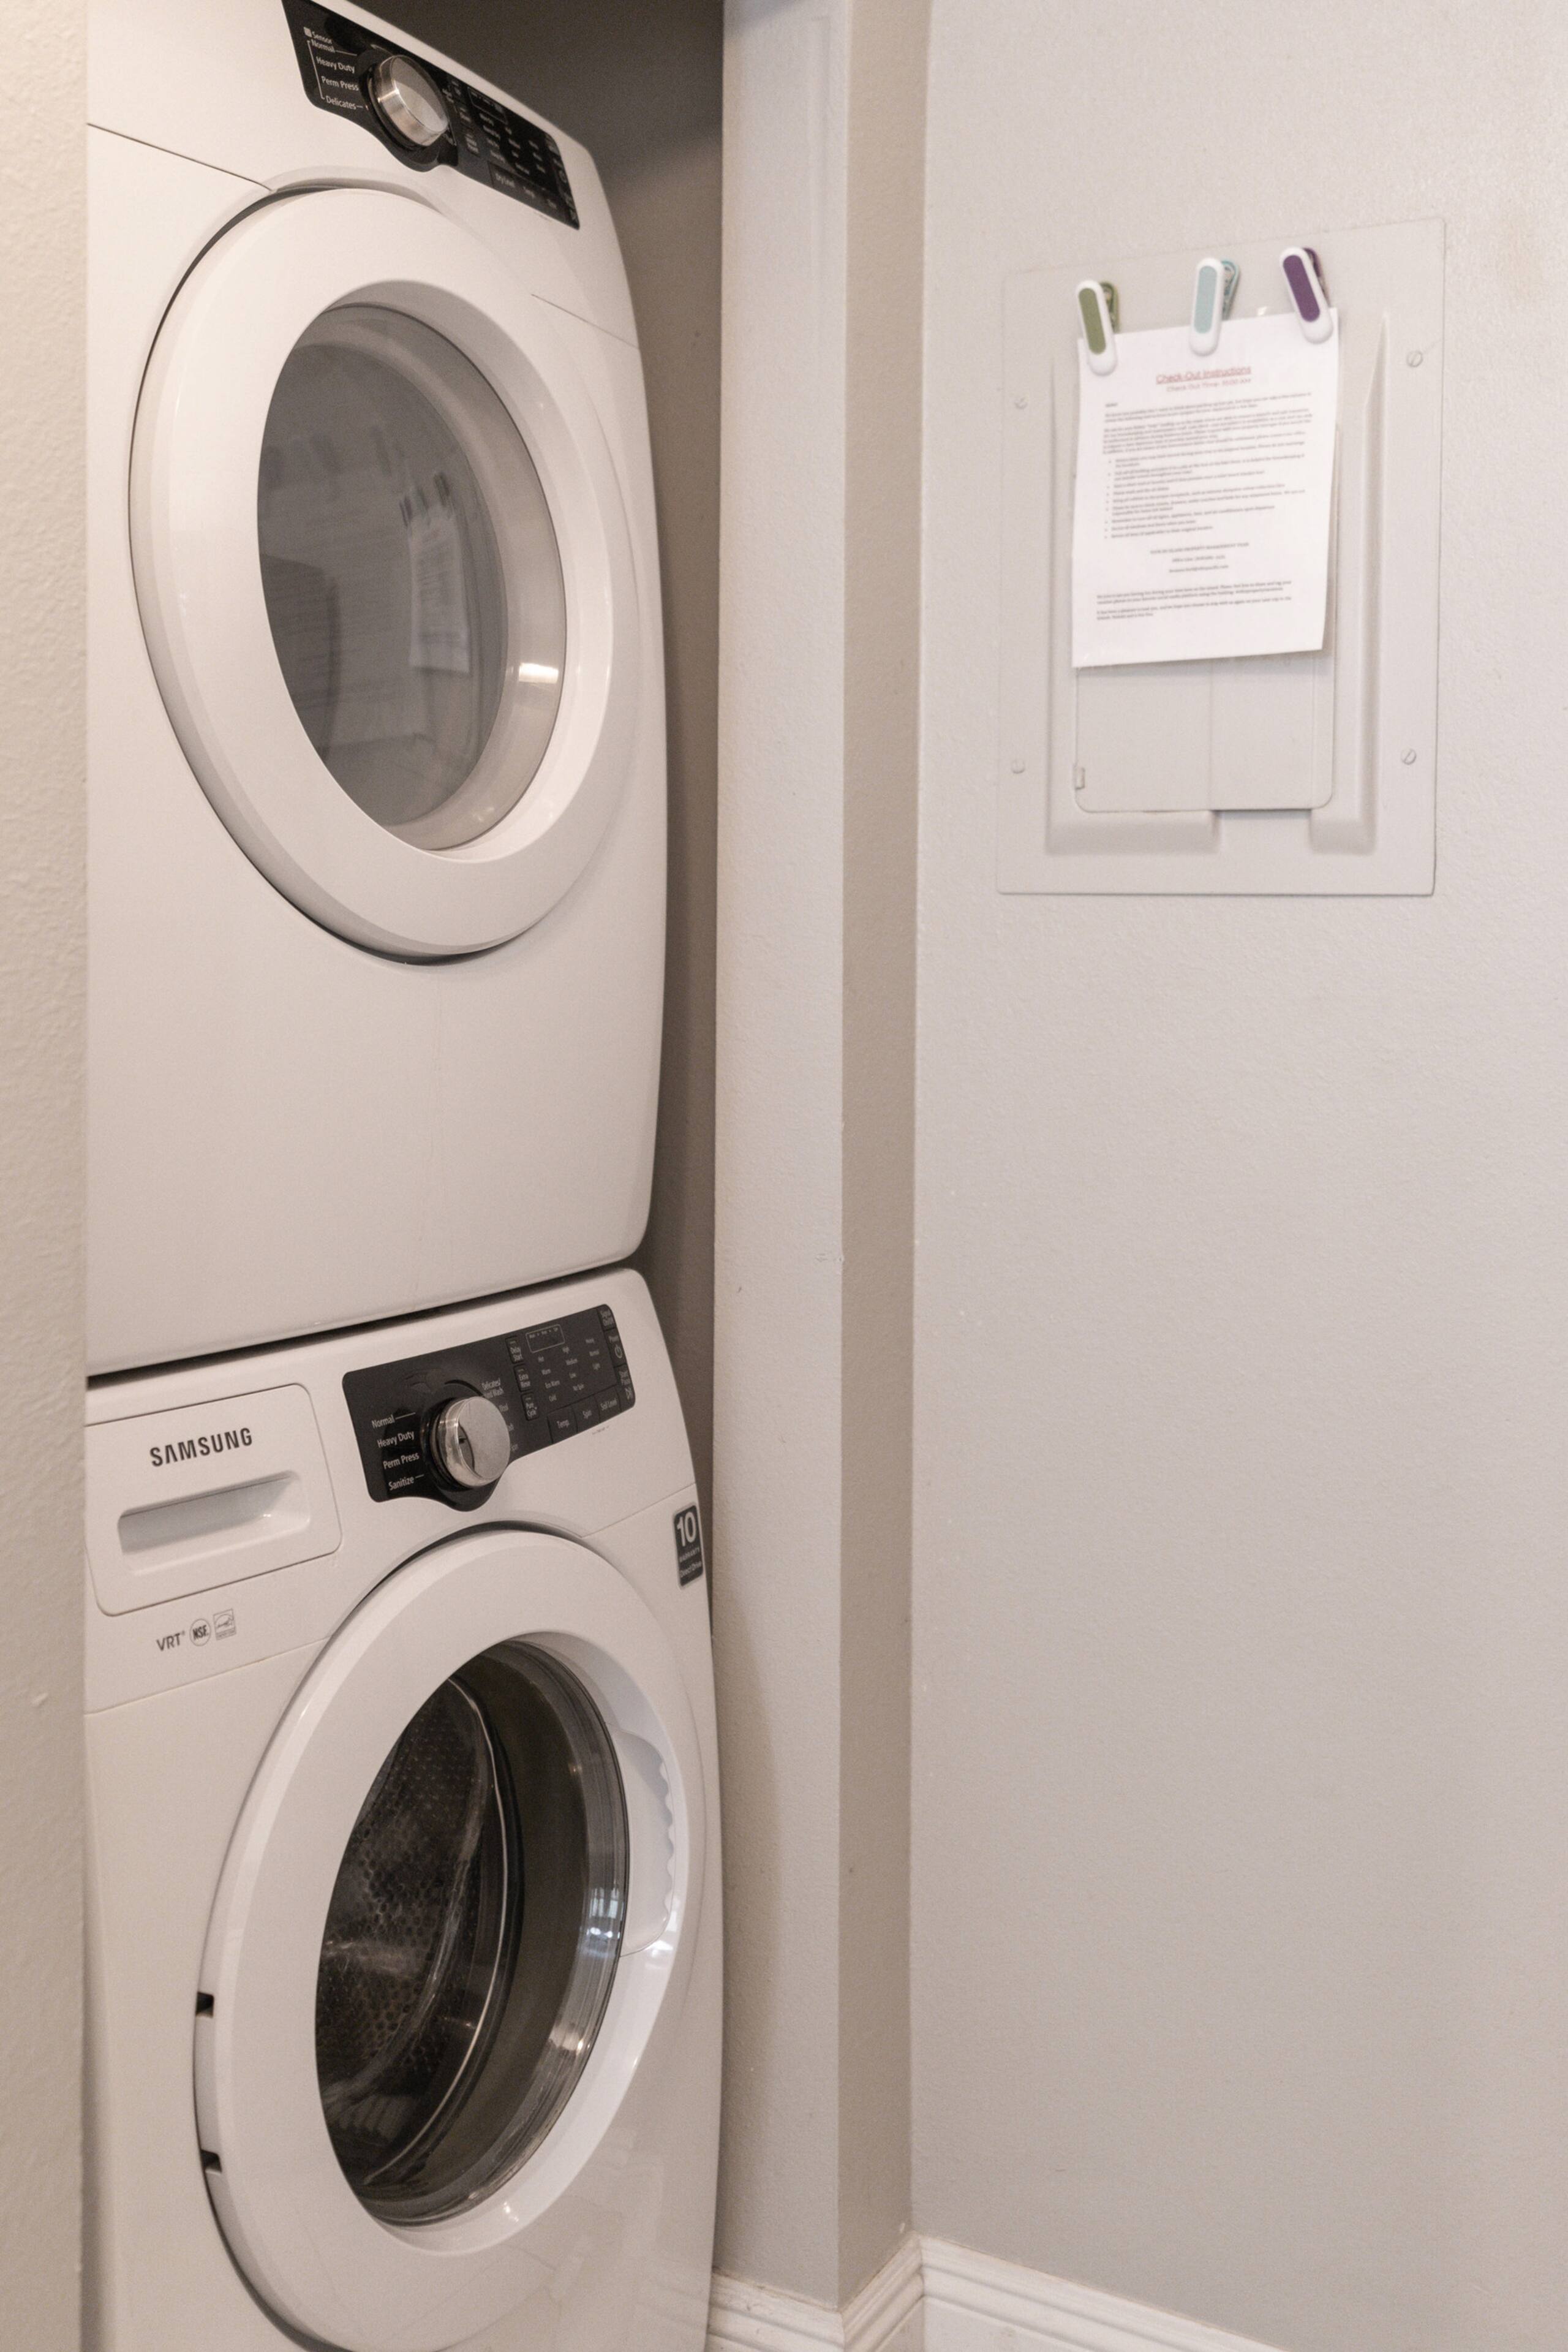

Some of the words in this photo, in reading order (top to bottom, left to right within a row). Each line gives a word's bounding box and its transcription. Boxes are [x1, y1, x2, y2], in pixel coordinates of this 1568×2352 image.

[311, 39, 336, 53] Normal
[316, 56, 337, 70] Heavy
[337, 62, 355, 74] Duty
[322, 75, 339, 88] Perm
[340, 80, 360, 91] Press
[326, 95, 356, 110] Delicates
[372, 1414, 395, 1429] Normal
[149, 1427, 252, 1467] SAMSUNG
[377, 1437, 398, 1448] Heavy
[398, 1431, 415, 1442] Duty
[383, 1459, 401, 1470] Perm
[401, 1452, 420, 1464] Press
[388, 1477, 415, 1491] Sanitize
[677, 1511, 697, 1548] 10
